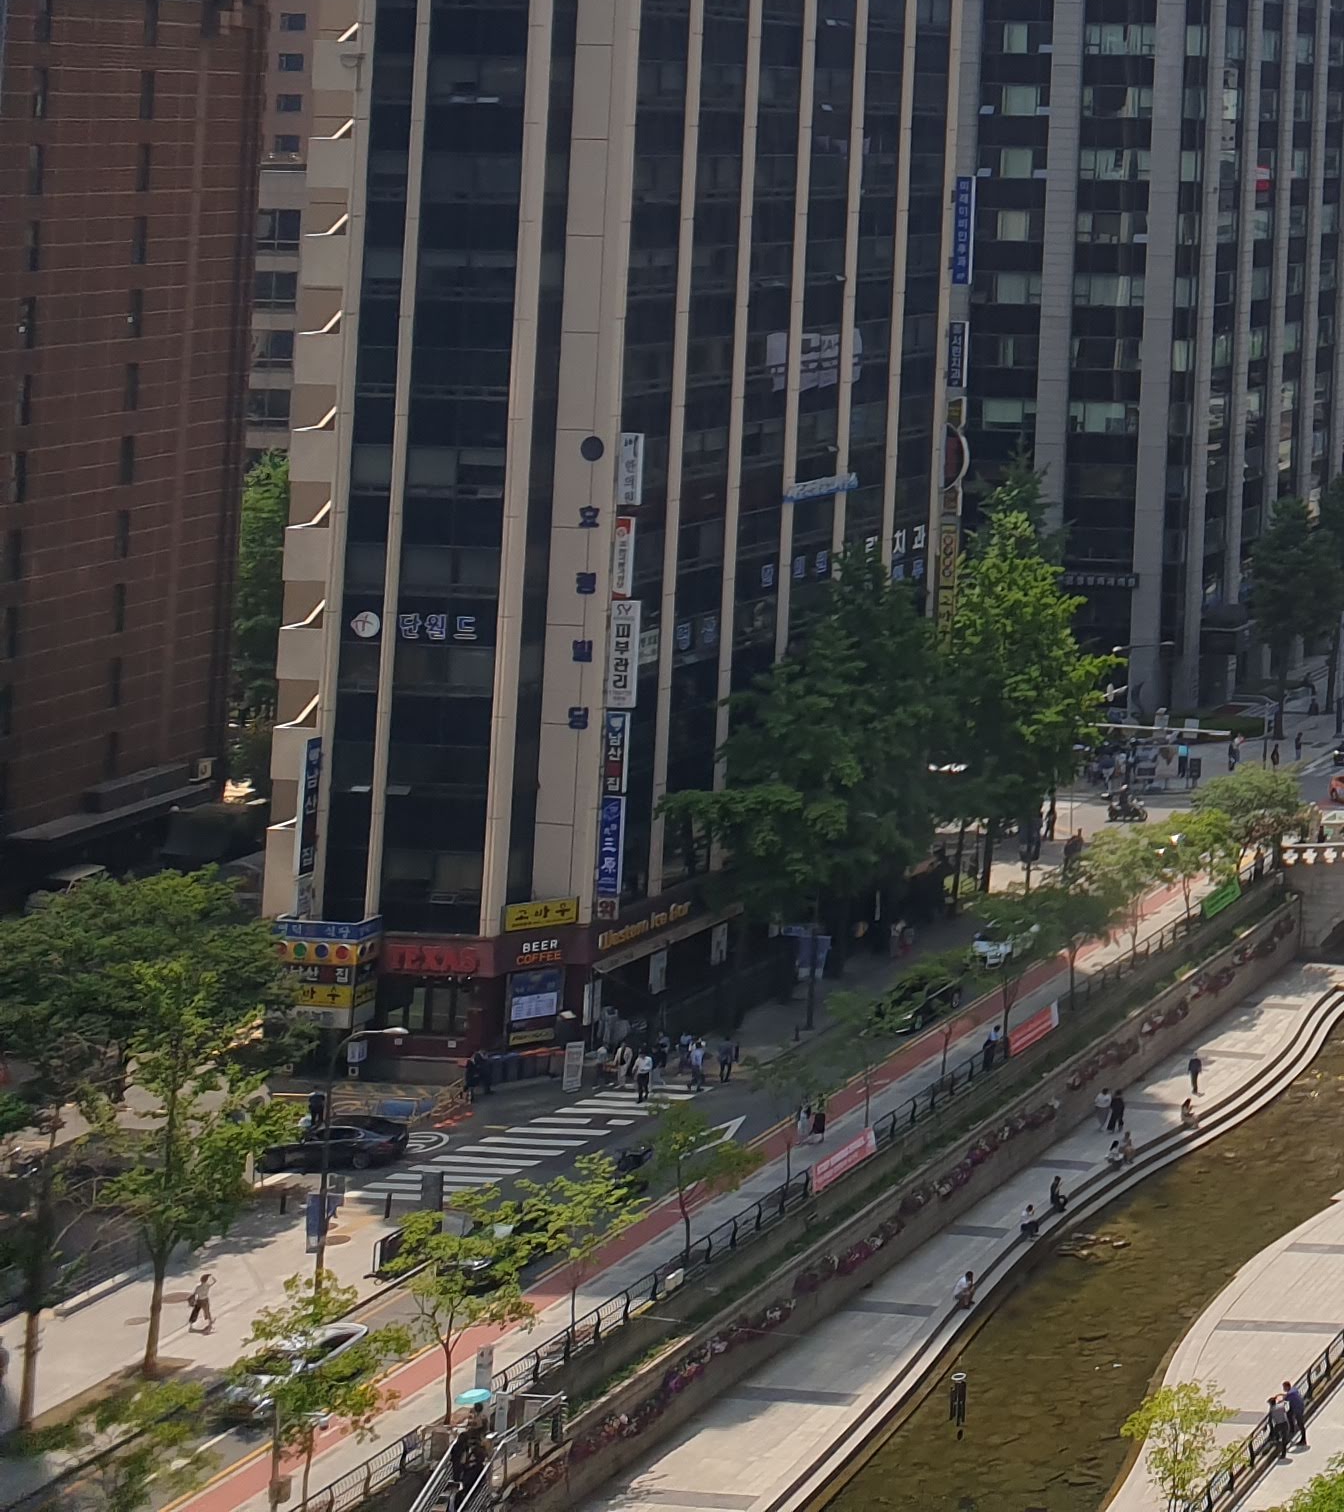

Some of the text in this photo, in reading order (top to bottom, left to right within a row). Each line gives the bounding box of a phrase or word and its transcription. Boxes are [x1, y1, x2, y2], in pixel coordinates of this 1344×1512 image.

[400, 613, 478, 640] 단월드
[613, 623, 631, 689] 피부관리
[389, 944, 480, 974] TEXAS
[516, 950, 563, 966] COFFEE
[522, 938, 559, 954] BEER
